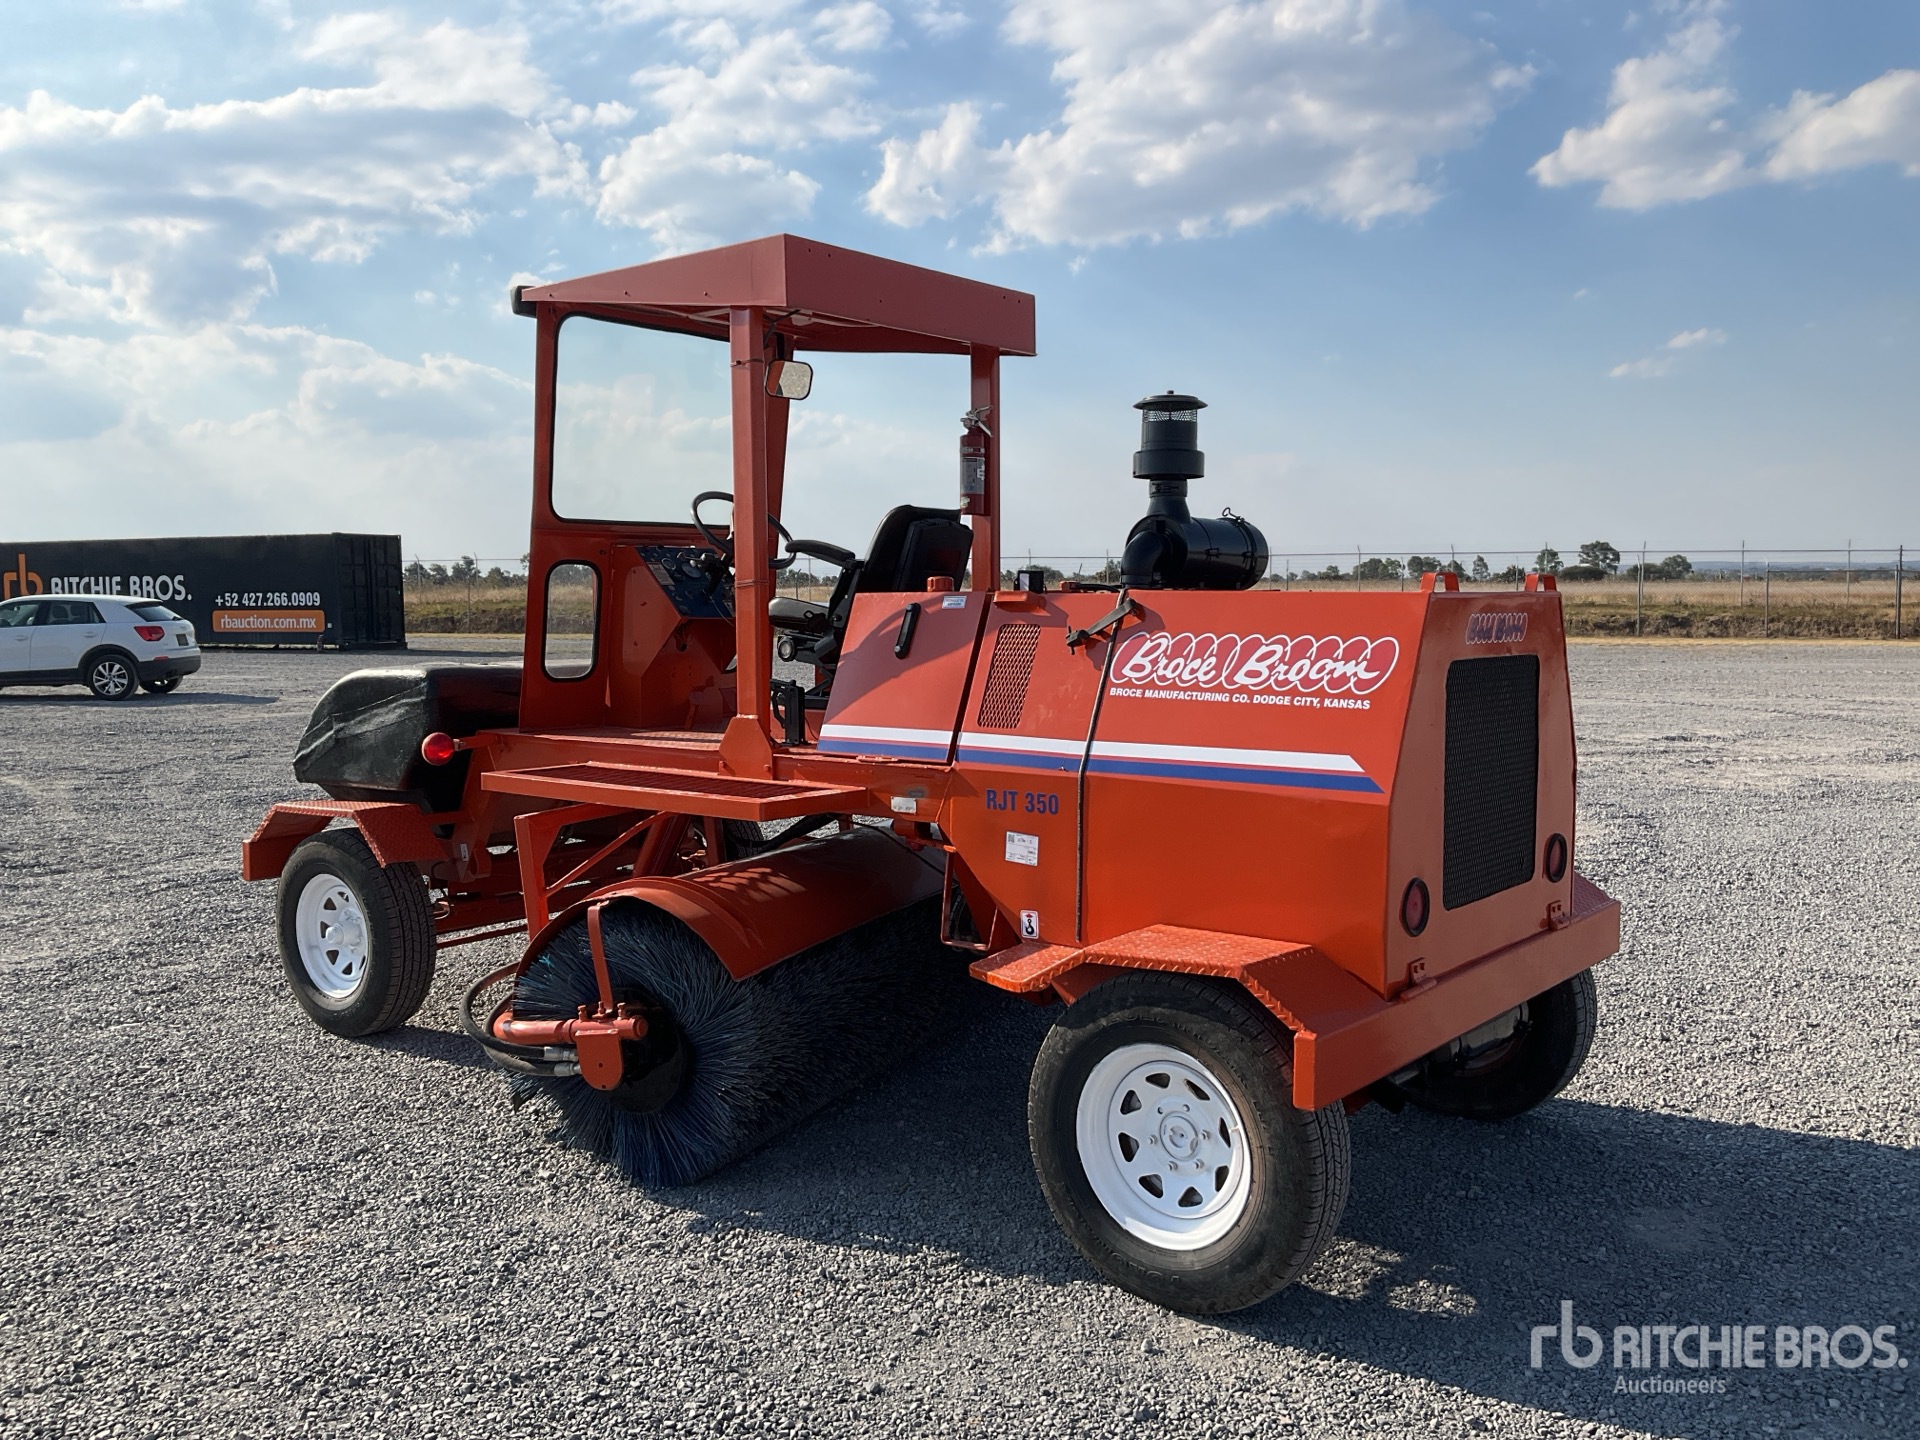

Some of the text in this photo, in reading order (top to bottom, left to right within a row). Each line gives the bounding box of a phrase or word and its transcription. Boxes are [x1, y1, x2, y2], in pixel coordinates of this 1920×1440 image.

[130, 575, 192, 600] BROS.
[215, 592, 321, 607] +52 427.266.0909
[220, 614, 317, 628] rbauction.com.mx
[1122, 636, 1381, 684] Broce Broom
[1109, 687, 1371, 710] BROCE MANUFACTURING CO. DODGE CITY, KANSAS
[986, 789, 1059, 815] RJT 350
